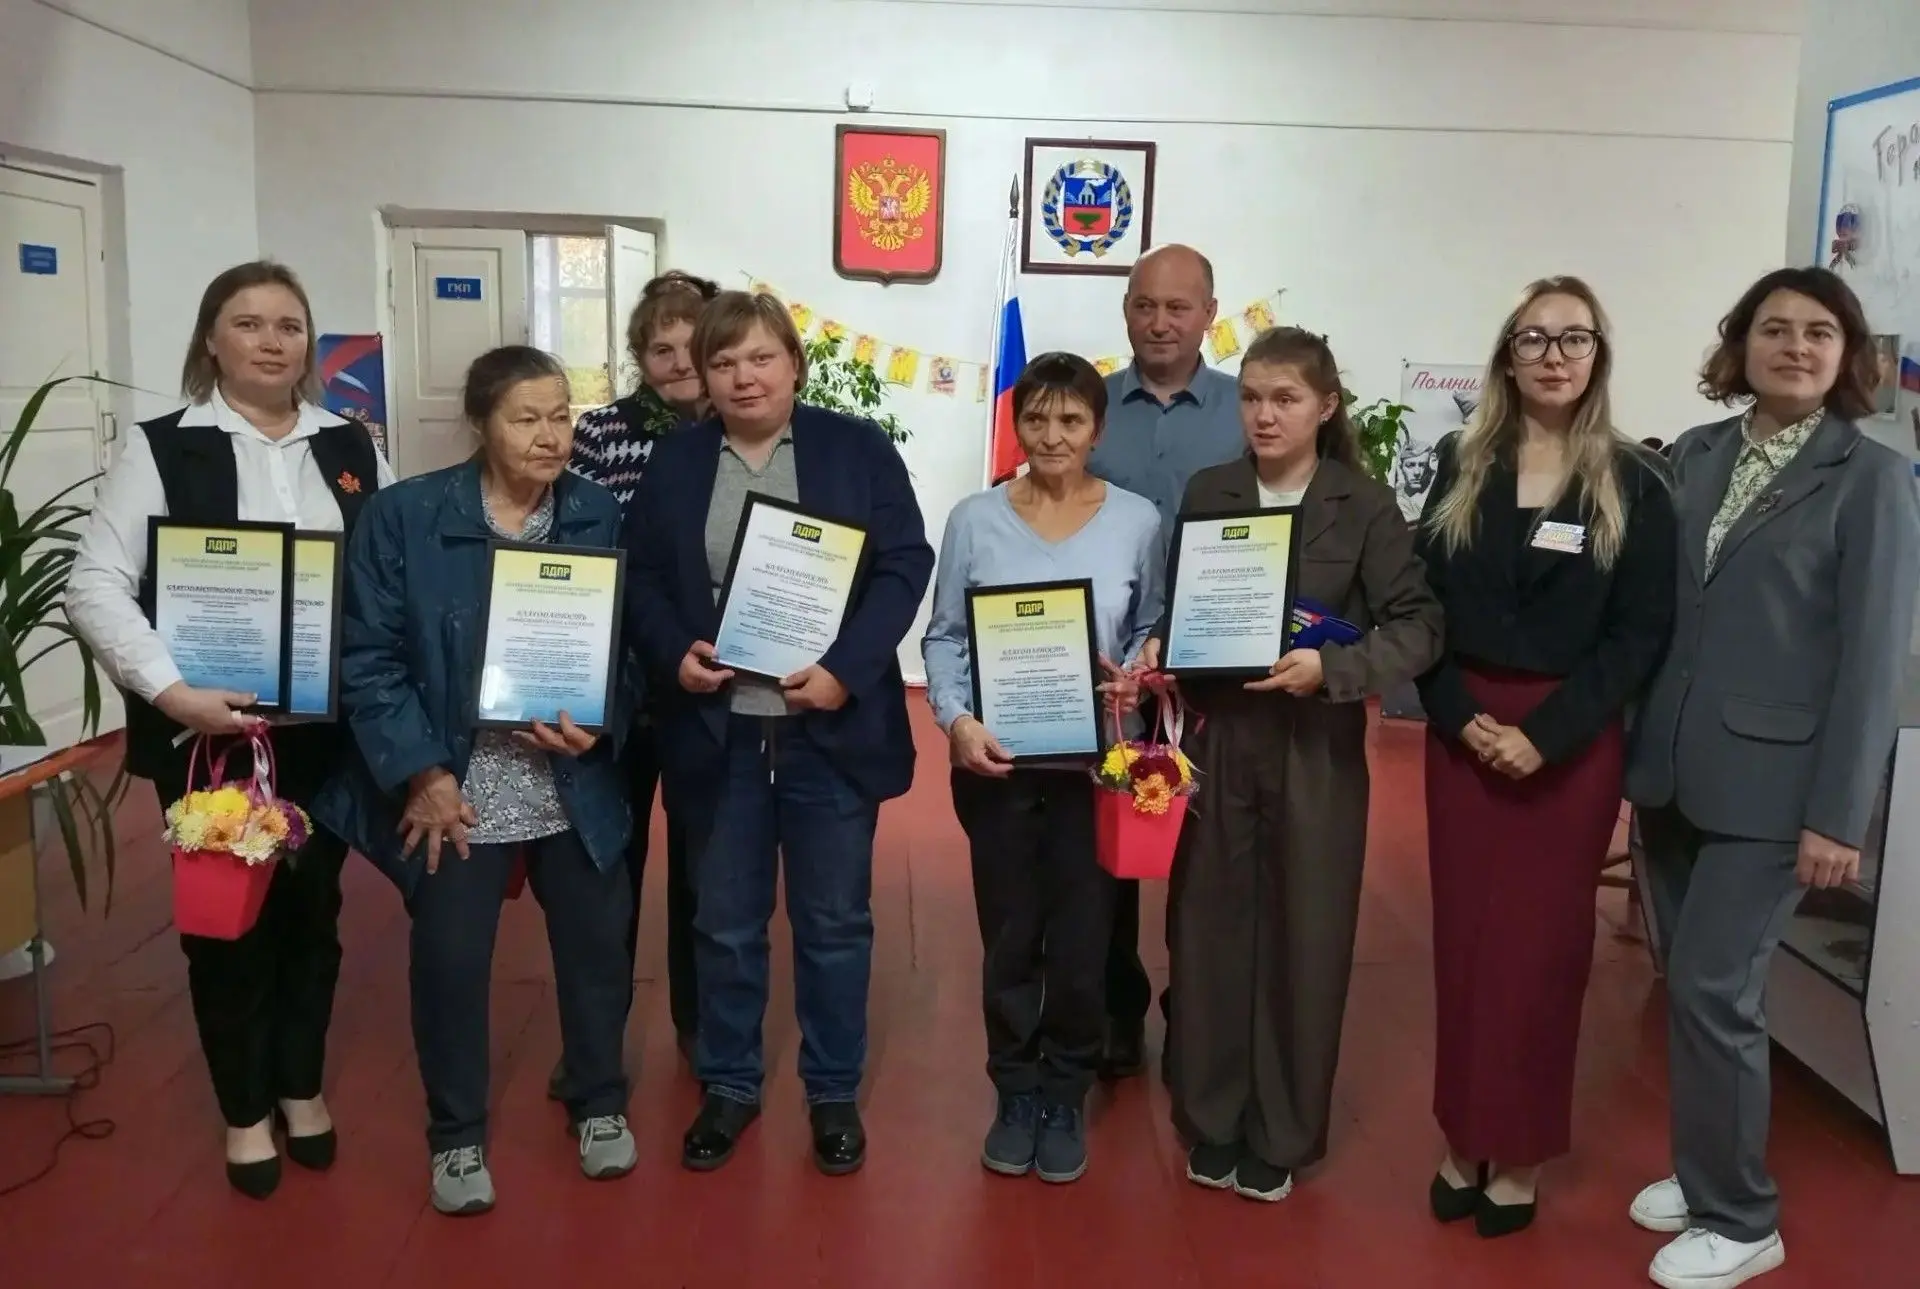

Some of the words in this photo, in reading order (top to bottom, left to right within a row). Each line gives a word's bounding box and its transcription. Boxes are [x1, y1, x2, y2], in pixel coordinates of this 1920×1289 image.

[447, 282, 471, 293] ГКП
[793, 523, 821, 541] ЛДПР
[1222, 527, 1249, 539] ЛДПР
[206, 538, 237, 552] ЛДПР
[541, 564, 571, 578] ЛДПР
[1017, 602, 1044, 615] ЛДПР
